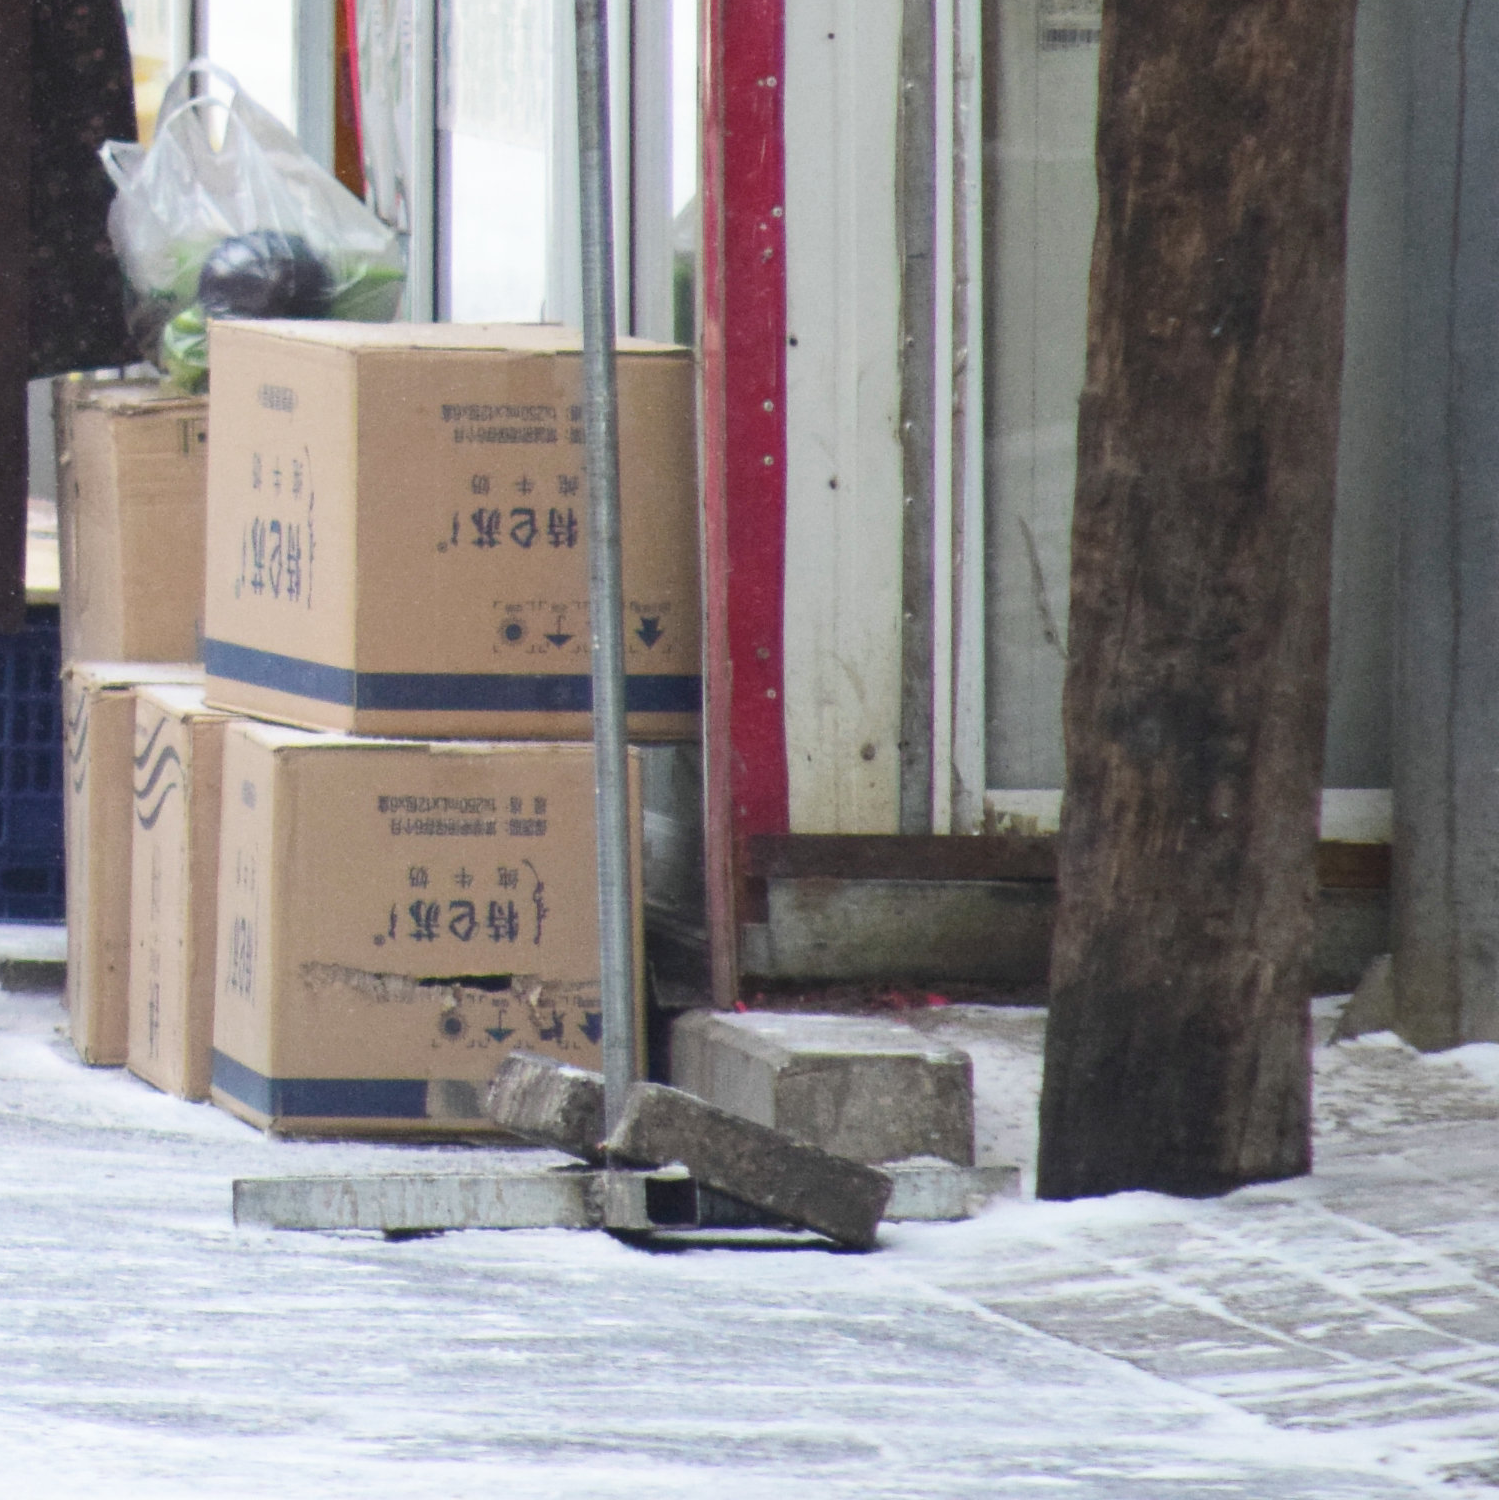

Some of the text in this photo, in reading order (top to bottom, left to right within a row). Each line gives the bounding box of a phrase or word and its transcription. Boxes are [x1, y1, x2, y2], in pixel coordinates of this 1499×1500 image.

[470, 473, 580, 496] 纯牛奶
[470, 507, 580, 550] 特仑苏
[407, 866, 519, 890] 纯牛奶
[407, 899, 520, 944] 特仑苏
